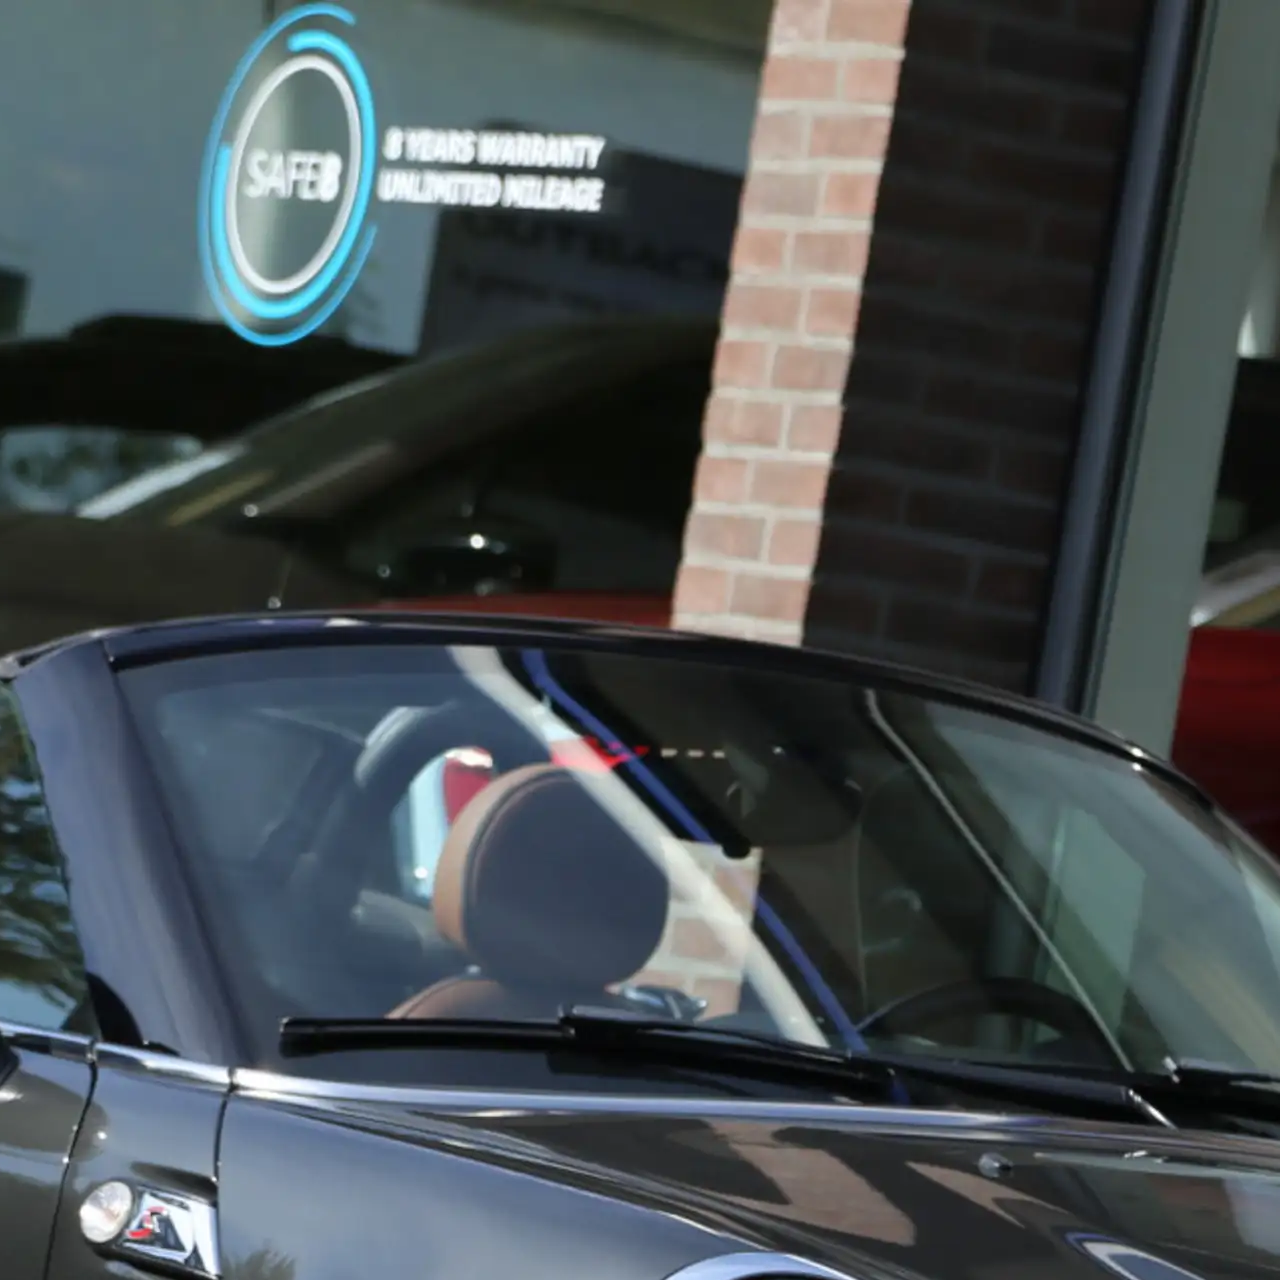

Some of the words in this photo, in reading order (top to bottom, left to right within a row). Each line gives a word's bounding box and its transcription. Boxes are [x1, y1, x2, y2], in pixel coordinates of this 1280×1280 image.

[384, 126, 403, 161] 8
[404, 127, 477, 164] YEARS
[477, 130, 605, 169] WARRANTY
[377, 168, 502, 208] UNLIMITED
[502, 173, 605, 213] MILEAGE
